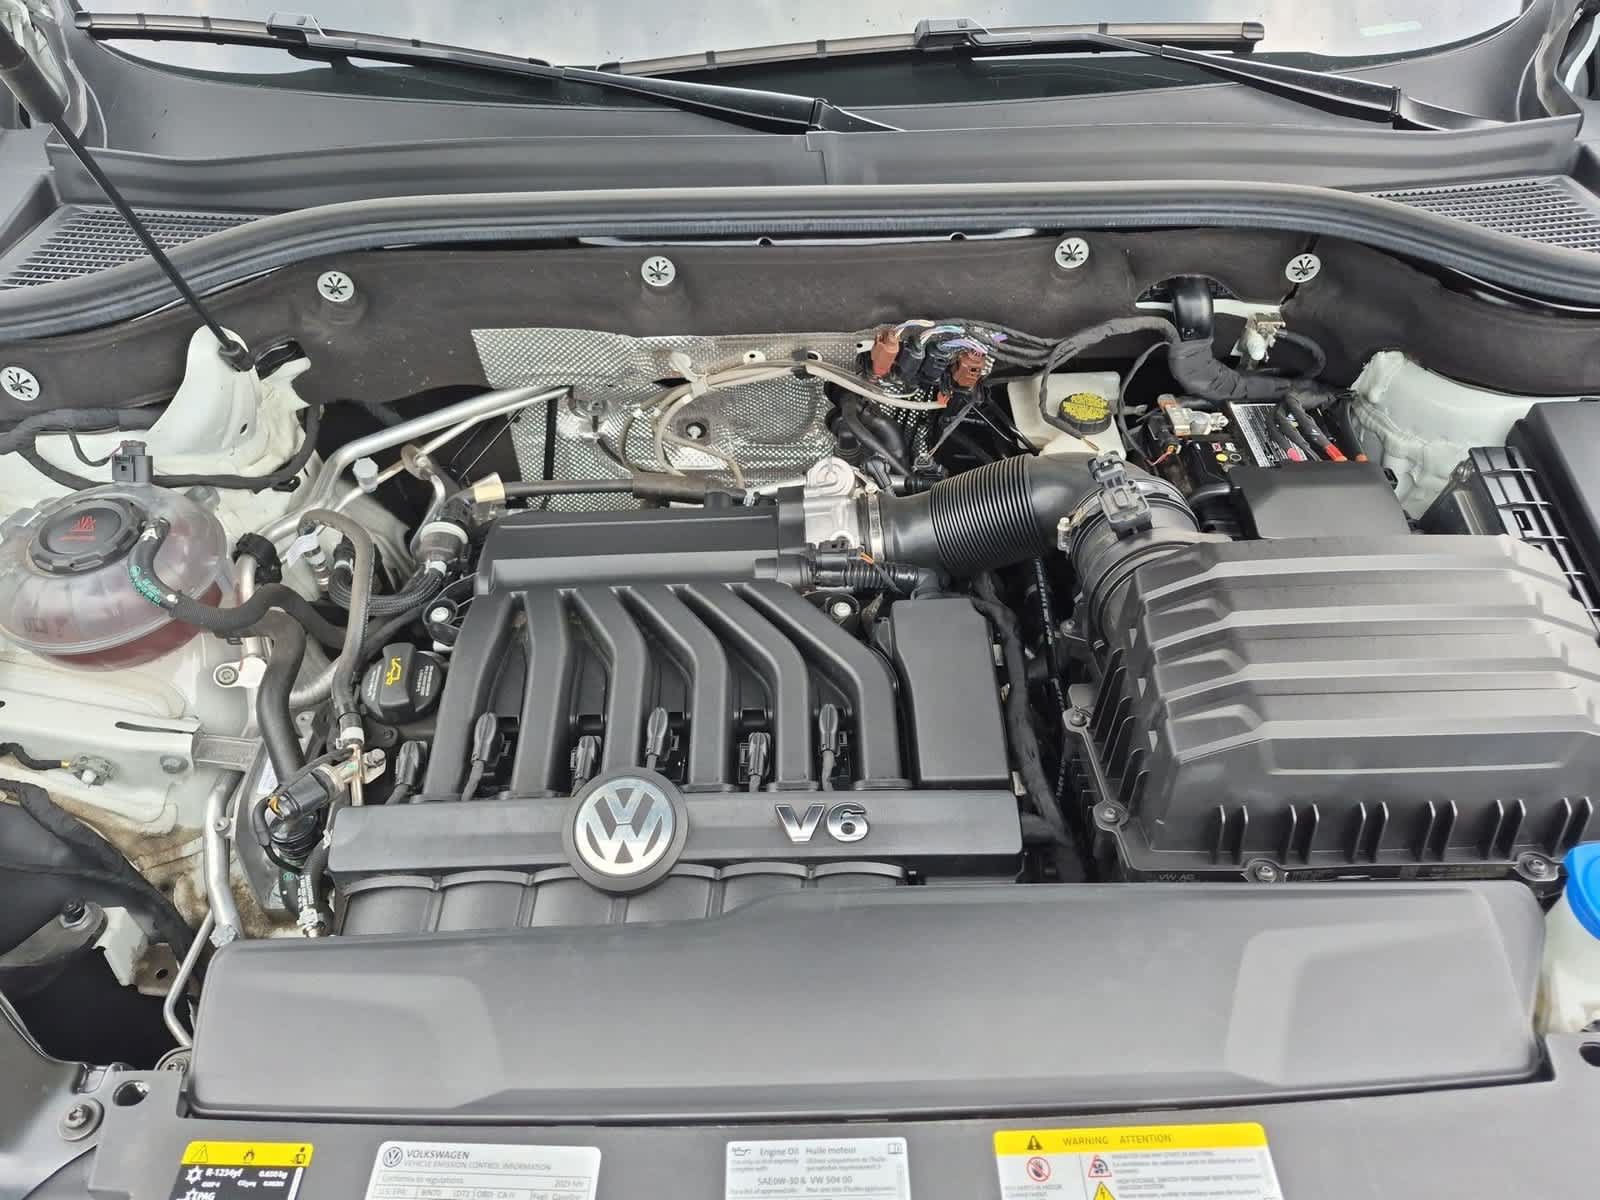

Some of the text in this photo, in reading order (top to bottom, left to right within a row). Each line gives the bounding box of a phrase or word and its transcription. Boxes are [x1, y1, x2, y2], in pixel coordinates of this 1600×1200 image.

[774, 801, 870, 843] V6
[1062, 1134, 1172, 1146] WARNING ATTENTION
[406, 1149, 471, 1160] VOLKSWAGEN
[759, 1147, 786, 1157] Engine
[805, 1145, 856, 1155] Huile moteur
